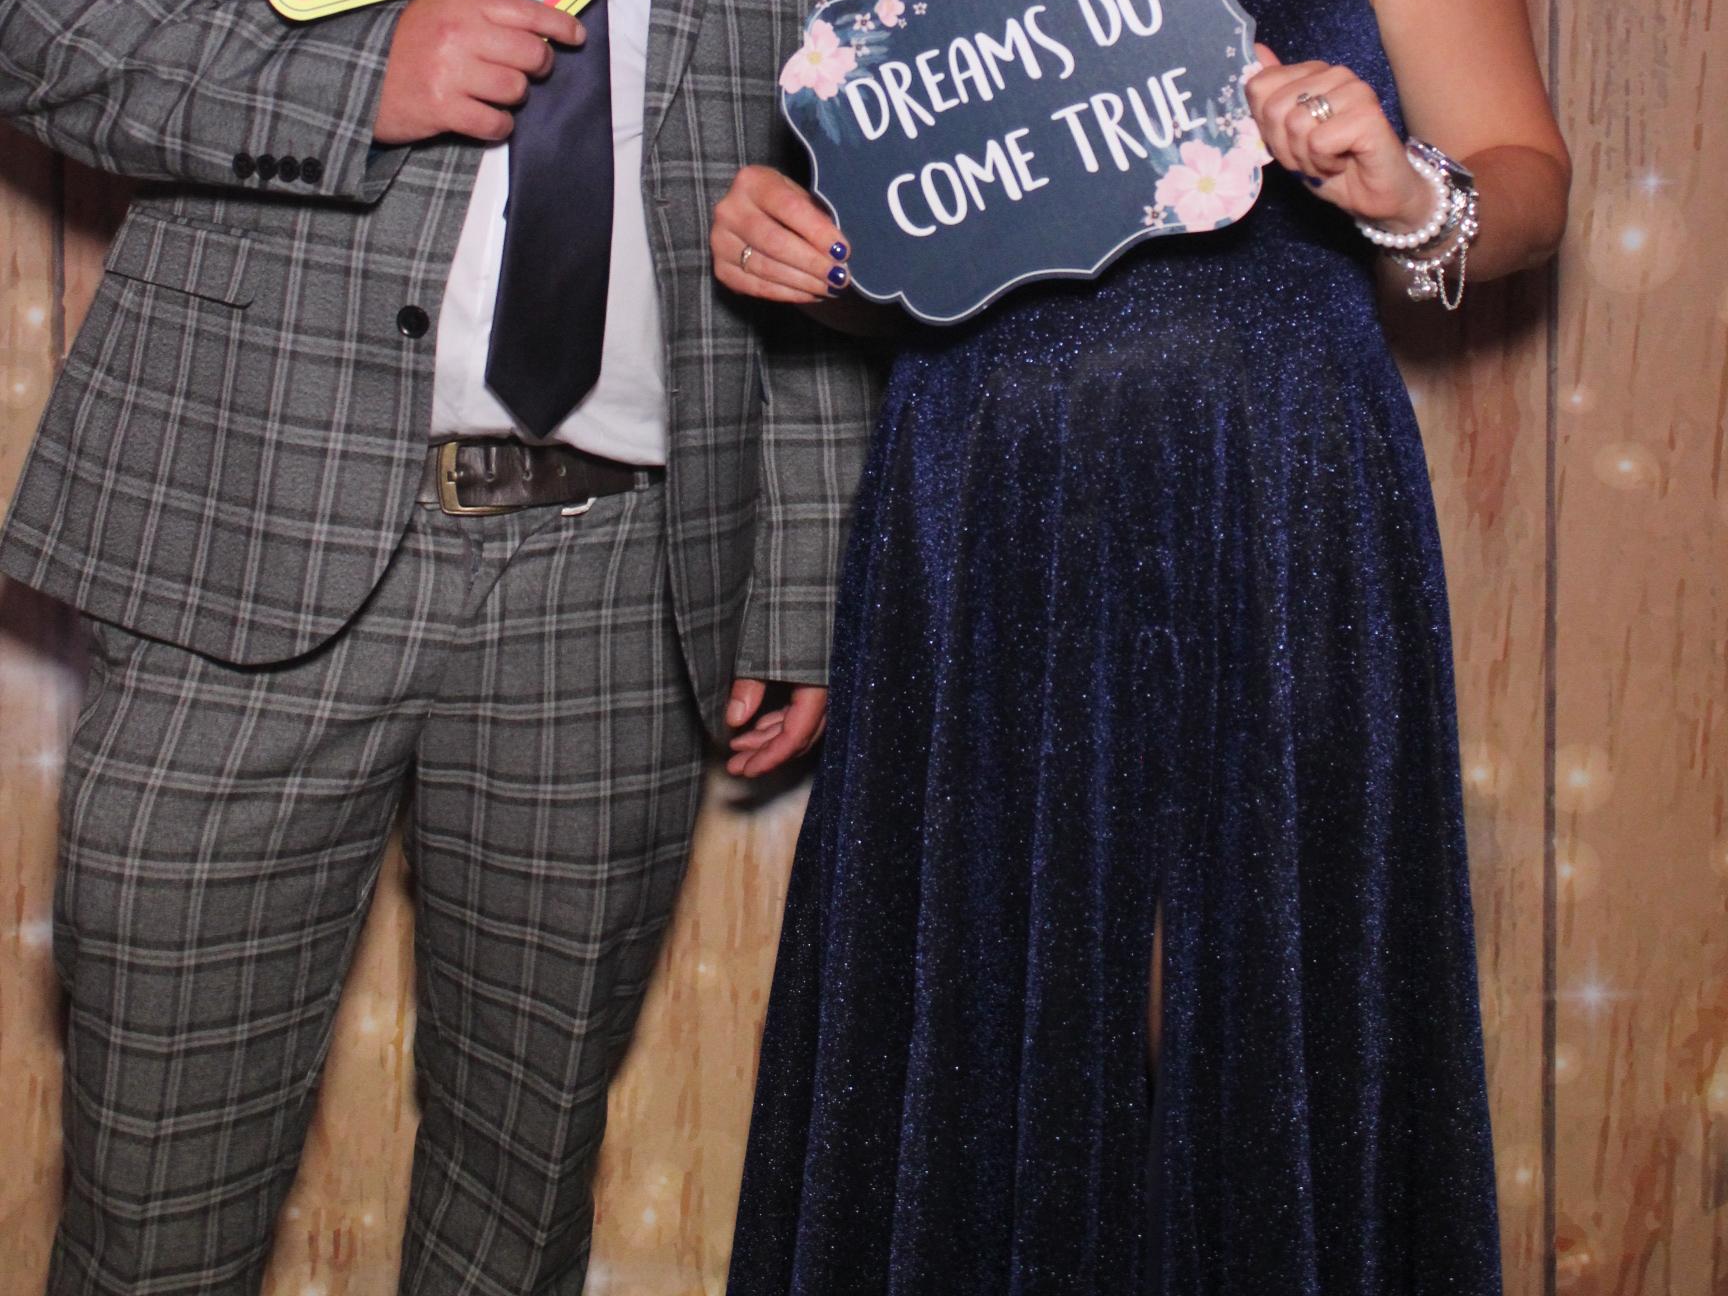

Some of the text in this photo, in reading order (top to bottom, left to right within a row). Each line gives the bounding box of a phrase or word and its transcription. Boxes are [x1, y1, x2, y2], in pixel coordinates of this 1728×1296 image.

[845, 5, 1075, 141] DREAMS
[887, 67, 1207, 237] COME TRUE
